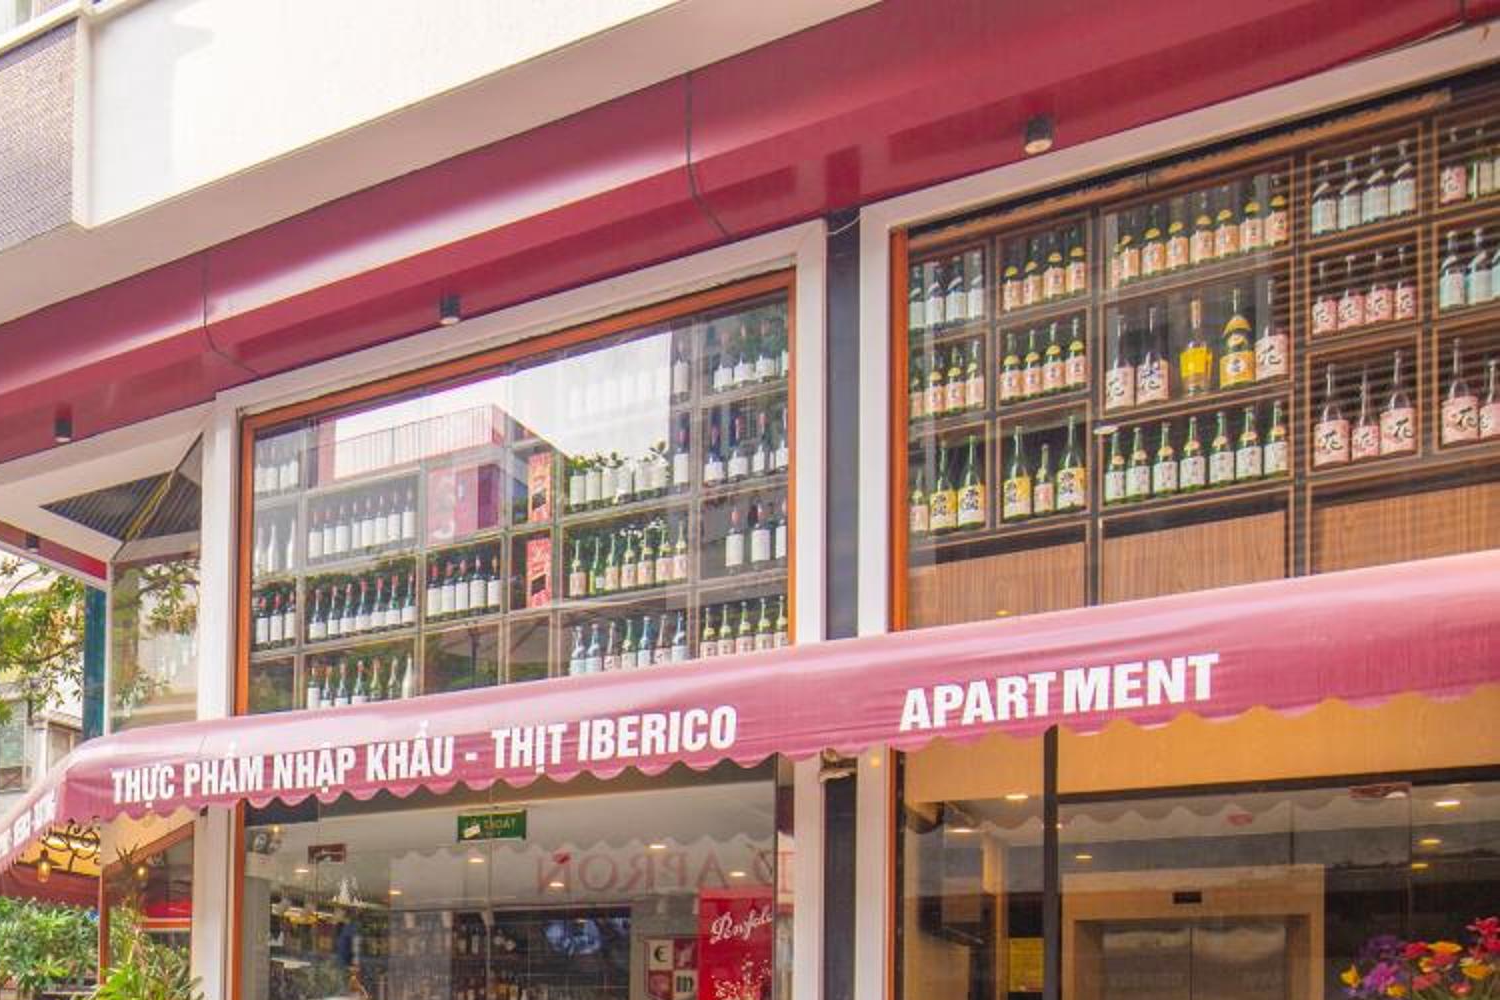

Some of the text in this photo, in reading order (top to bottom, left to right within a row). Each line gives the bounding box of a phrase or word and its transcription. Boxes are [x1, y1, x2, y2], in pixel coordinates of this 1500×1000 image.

[899, 652, 1221, 733] APARTMENT
[110, 762, 176, 808] THỰC
[272, 742, 358, 793] NHẬP
[490, 722, 568, 773] THỊT
[576, 705, 739, 763] IBERICO
